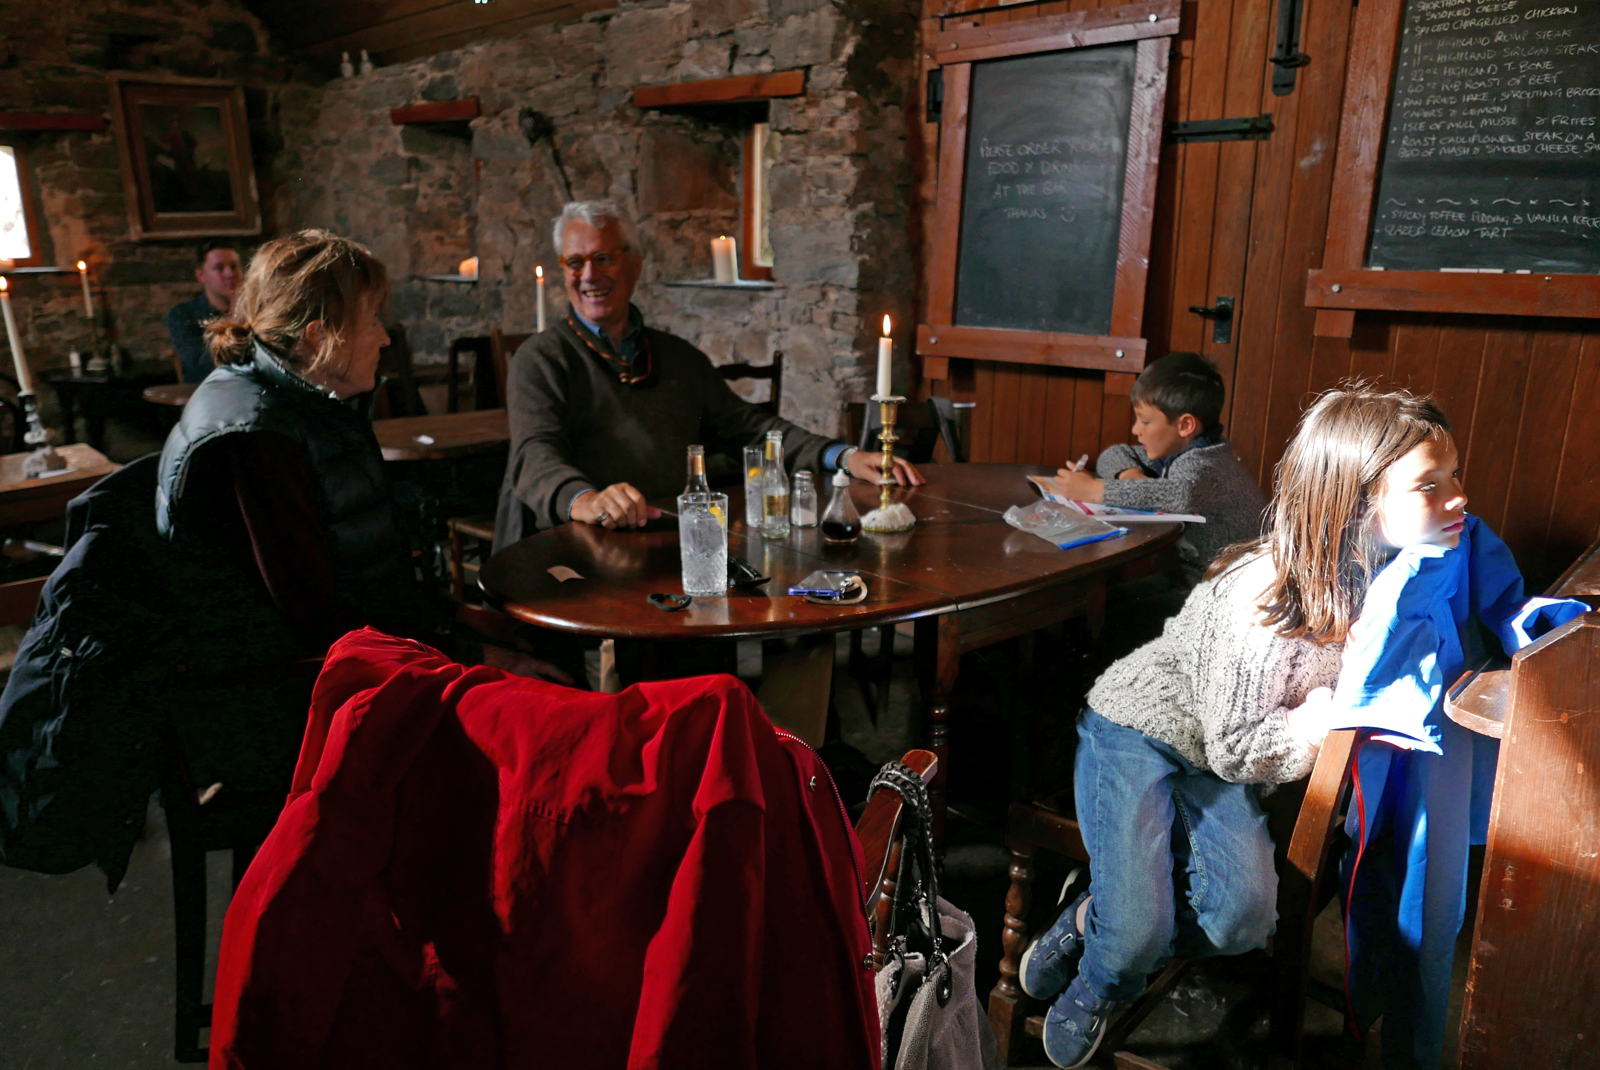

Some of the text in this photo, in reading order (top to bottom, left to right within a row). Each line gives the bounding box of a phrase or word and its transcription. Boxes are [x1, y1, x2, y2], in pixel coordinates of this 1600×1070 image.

[1425, 8, 1471, 21] SMOKED
[1475, 1, 1518, 14] CHEESE
[1524, 6, 1578, 20] CHICKEN
[1535, 29, 1574, 41] STEAK
[1436, 50, 1497, 64] HIGHLAND
[1554, 44, 1600, 56] STEAK
[1442, 64, 1498, 78] HIGHLAND
[1464, 77, 1500, 90] ROAST
[1528, 71, 1564, 84] BEEF
[1425, 94, 1458, 106] FRIED
[1500, 88, 1562, 102] SPROUTING
[1462, 105, 1508, 116] LEMON
[1402, 120, 1427, 132] ISLE
[1428, 121, 1447, 131] OF
[1551, 115, 1597, 127] FRITES
[1439, 133, 1518, 145] CAULIFLOWER
[1522, 131, 1564, 143] STEAK
[1564, 132, 1584, 143] ON
[1586, 131, 1597, 141] A
[1017, 140, 1062, 156] ORDER
[1439, 145, 1470, 156] MASH
[1485, 144, 1532, 154] SMOKED
[1535, 143, 1580, 154] CHEESE
[987, 161, 1020, 176] FOOD
[992, 183, 1013, 200] AT
[1015, 183, 1037, 196] THE
[1003, 207, 1048, 220] THANKS
[1429, 211, 1467, 222] TOFFEE
[1526, 213, 1569, 225] VANILLA
[1431, 226, 1471, 239] LEMON
[1473, 226, 1515, 240] TART
